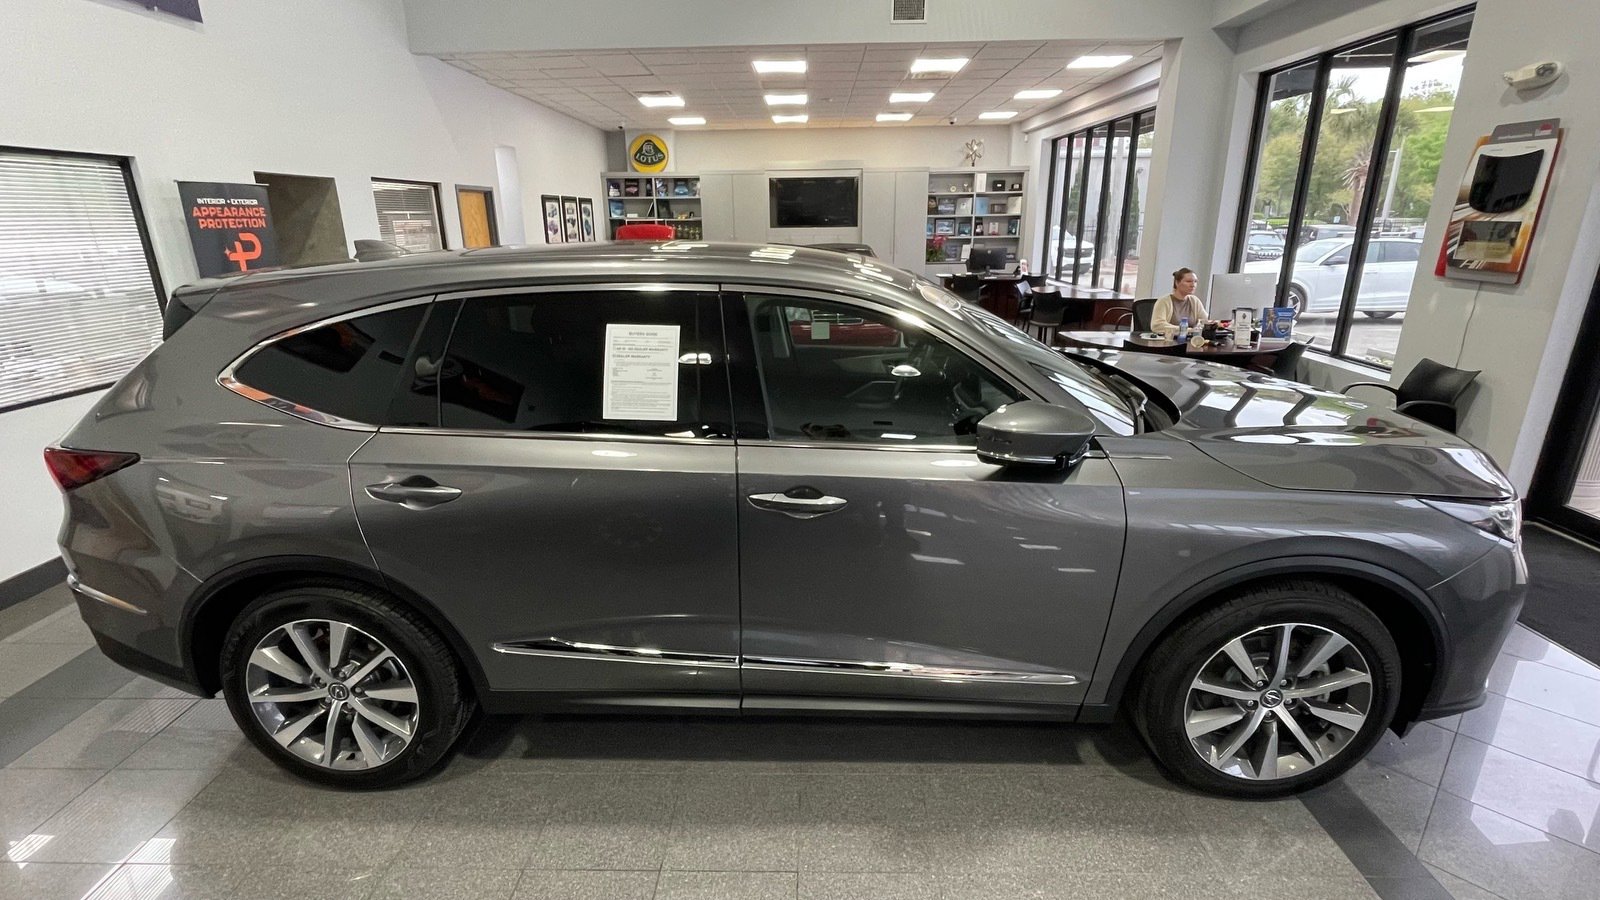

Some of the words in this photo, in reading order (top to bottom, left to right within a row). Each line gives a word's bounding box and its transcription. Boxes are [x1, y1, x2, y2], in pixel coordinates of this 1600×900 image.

[635, 153, 664, 163] LOTUS
[193, 206, 266, 216] APPEARANCE
[198, 218, 266, 229] PROTECTION
